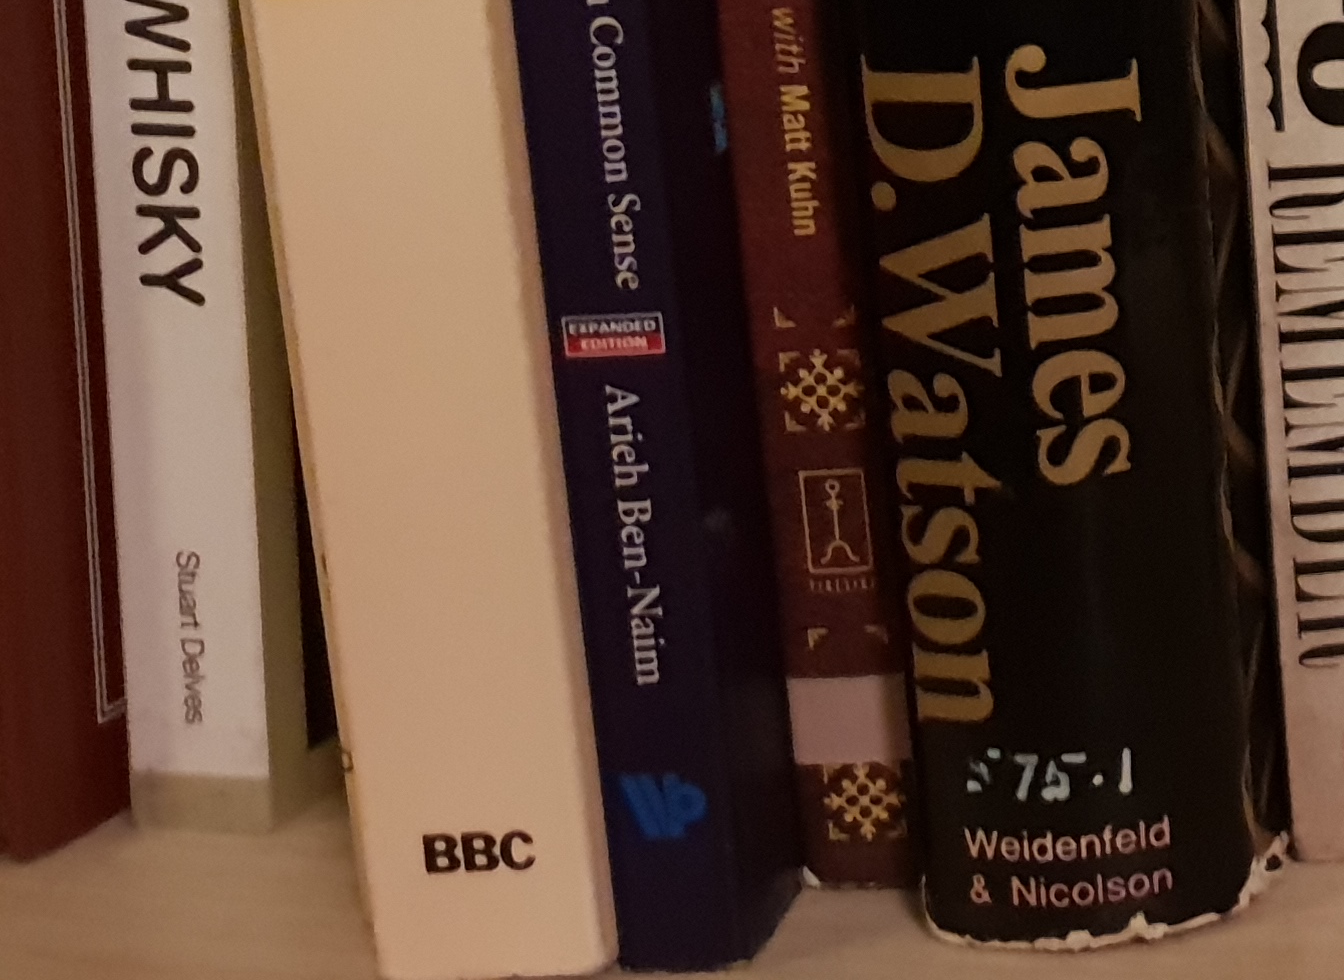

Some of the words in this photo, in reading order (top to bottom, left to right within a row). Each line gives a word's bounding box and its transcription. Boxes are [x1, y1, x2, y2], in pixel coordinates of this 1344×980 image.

[768, 6, 809, 74] with
[585, 15, 633, 184] Common
[776, 83, 817, 153] Matt
[786, 162, 824, 236] Kuhn
[605, 191, 643, 289] Sense
[1002, 44, 1147, 486] James
[568, 321, 656, 335] EXPANDED
[581, 336, 648, 350] EDITION
[602, 383, 643, 489] Arieh
[174, 551, 203, 629] Stuart
[617, 498, 665, 685] Ben-Naim
[180, 638, 208, 724] Delves
[422, 831, 537, 873] BBC
[963, 812, 1172, 864] Weidenfeld
[968, 873, 993, 905] &
[1011, 867, 1174, 909] Nicolson
